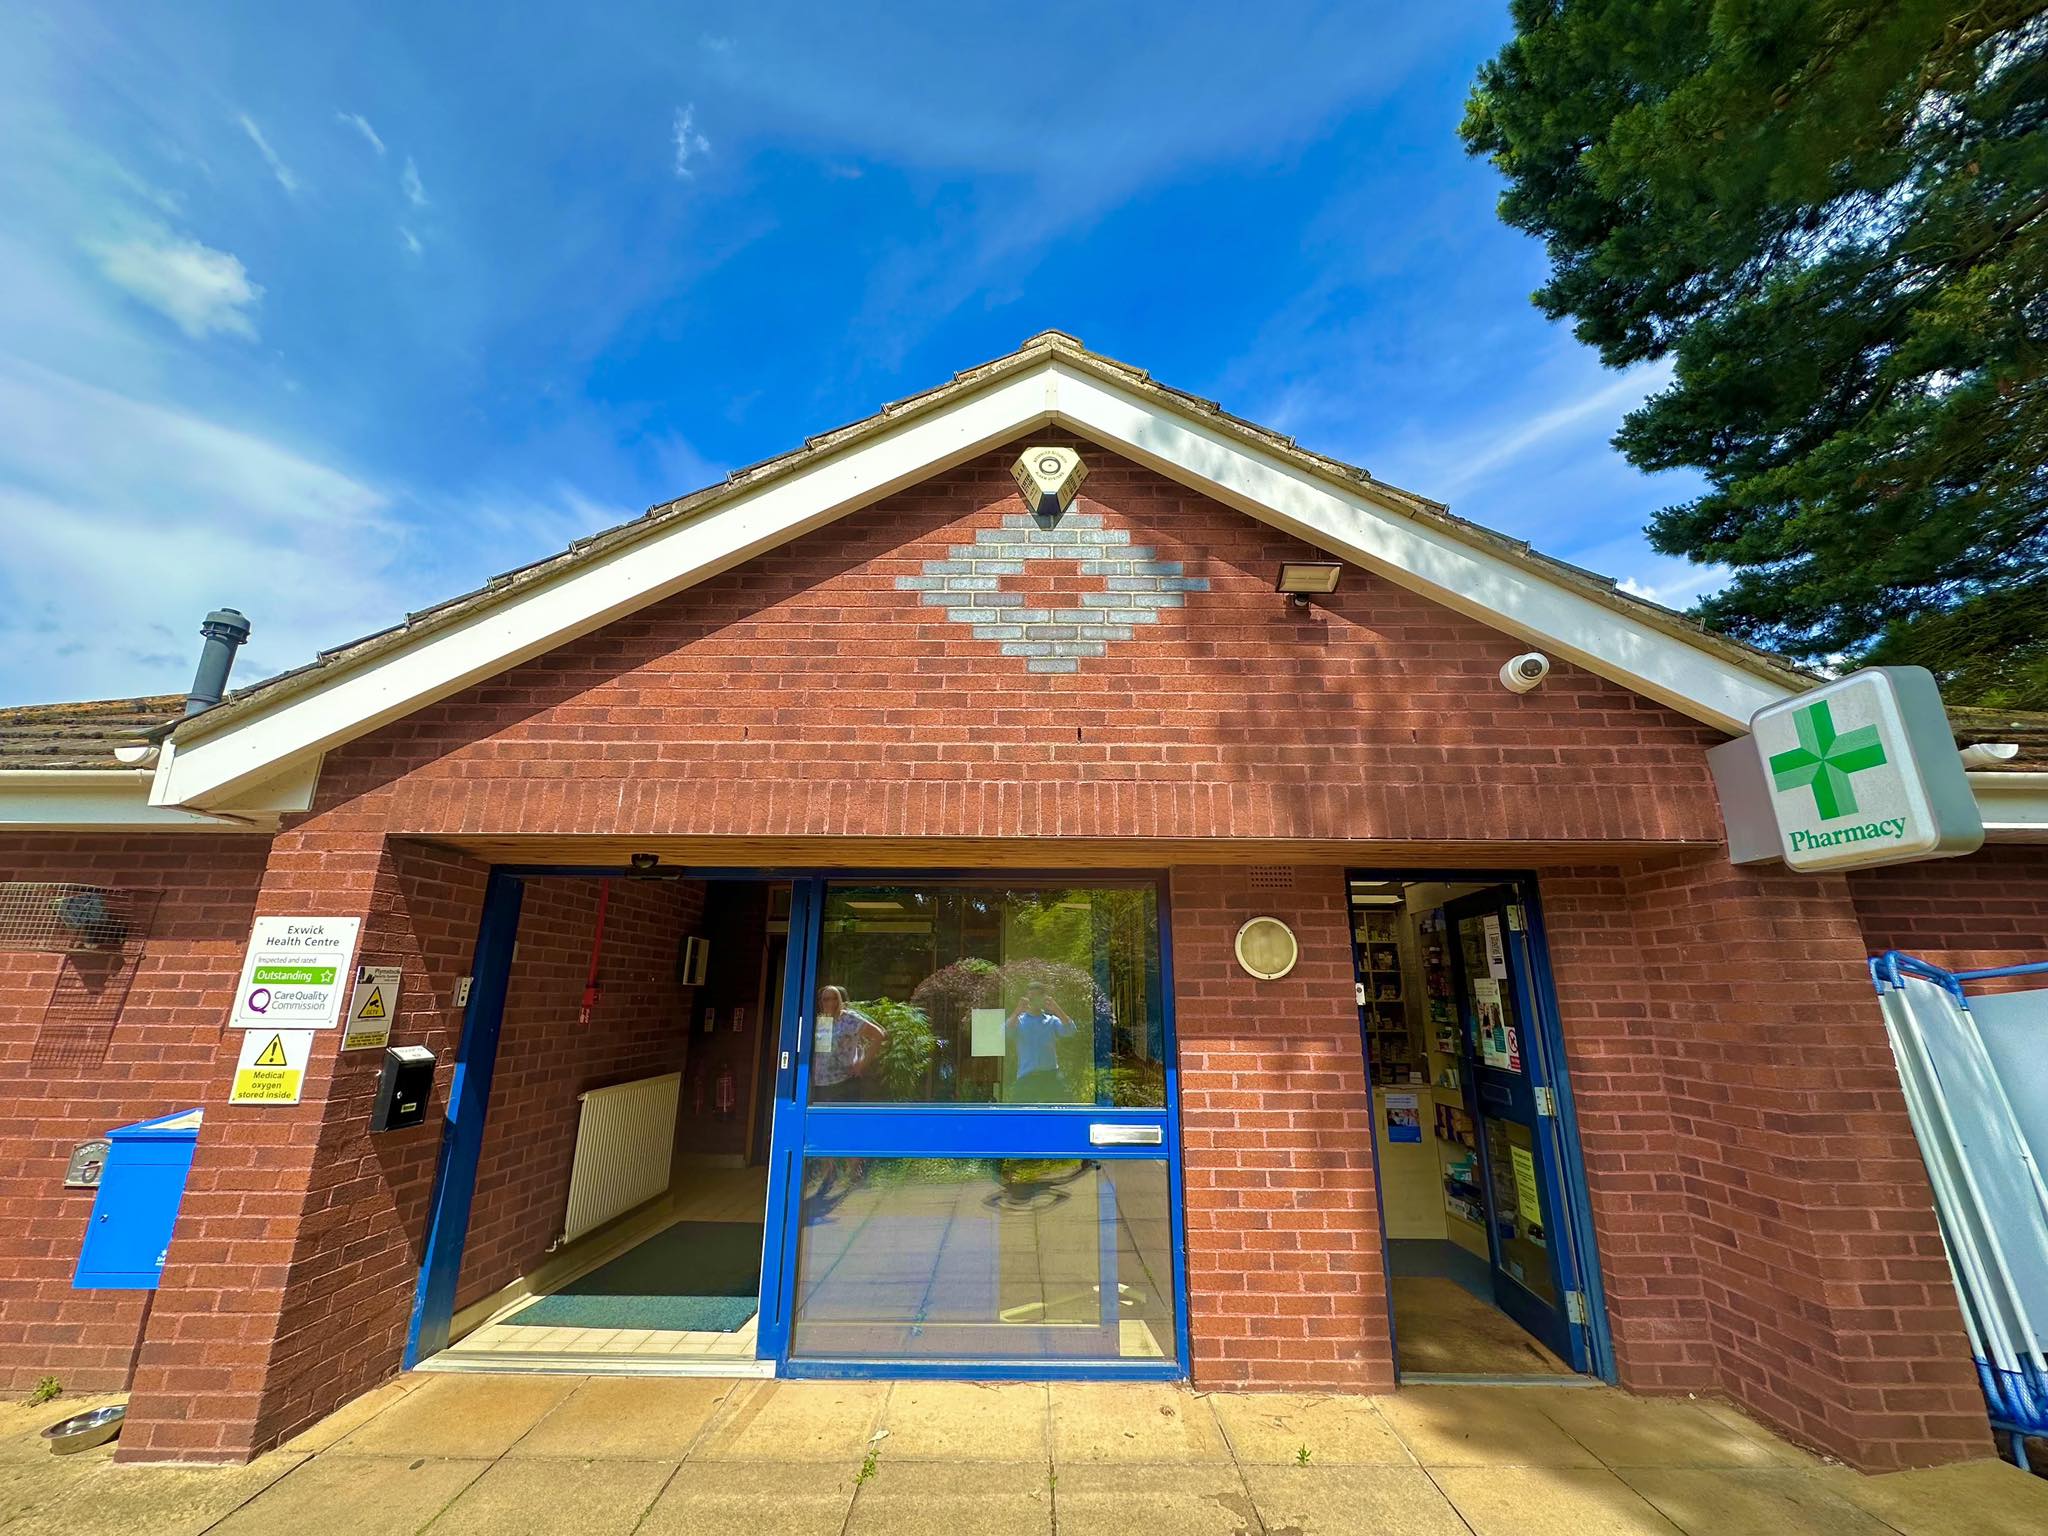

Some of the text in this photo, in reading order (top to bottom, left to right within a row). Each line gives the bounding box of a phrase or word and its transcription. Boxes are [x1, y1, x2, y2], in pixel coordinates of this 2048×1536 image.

[1789, 817, 1906, 852] Pharmacy
[287, 925, 325, 935] Exwick
[266, 937, 340, 947] Health Centre
[258, 957, 287, 965] Inspected
[256, 970, 313, 983] Outstanding
[271, 1001, 326, 1011] Commission
[253, 1071, 286, 1079] Medical
[251, 1082, 282, 1090] oxygen
